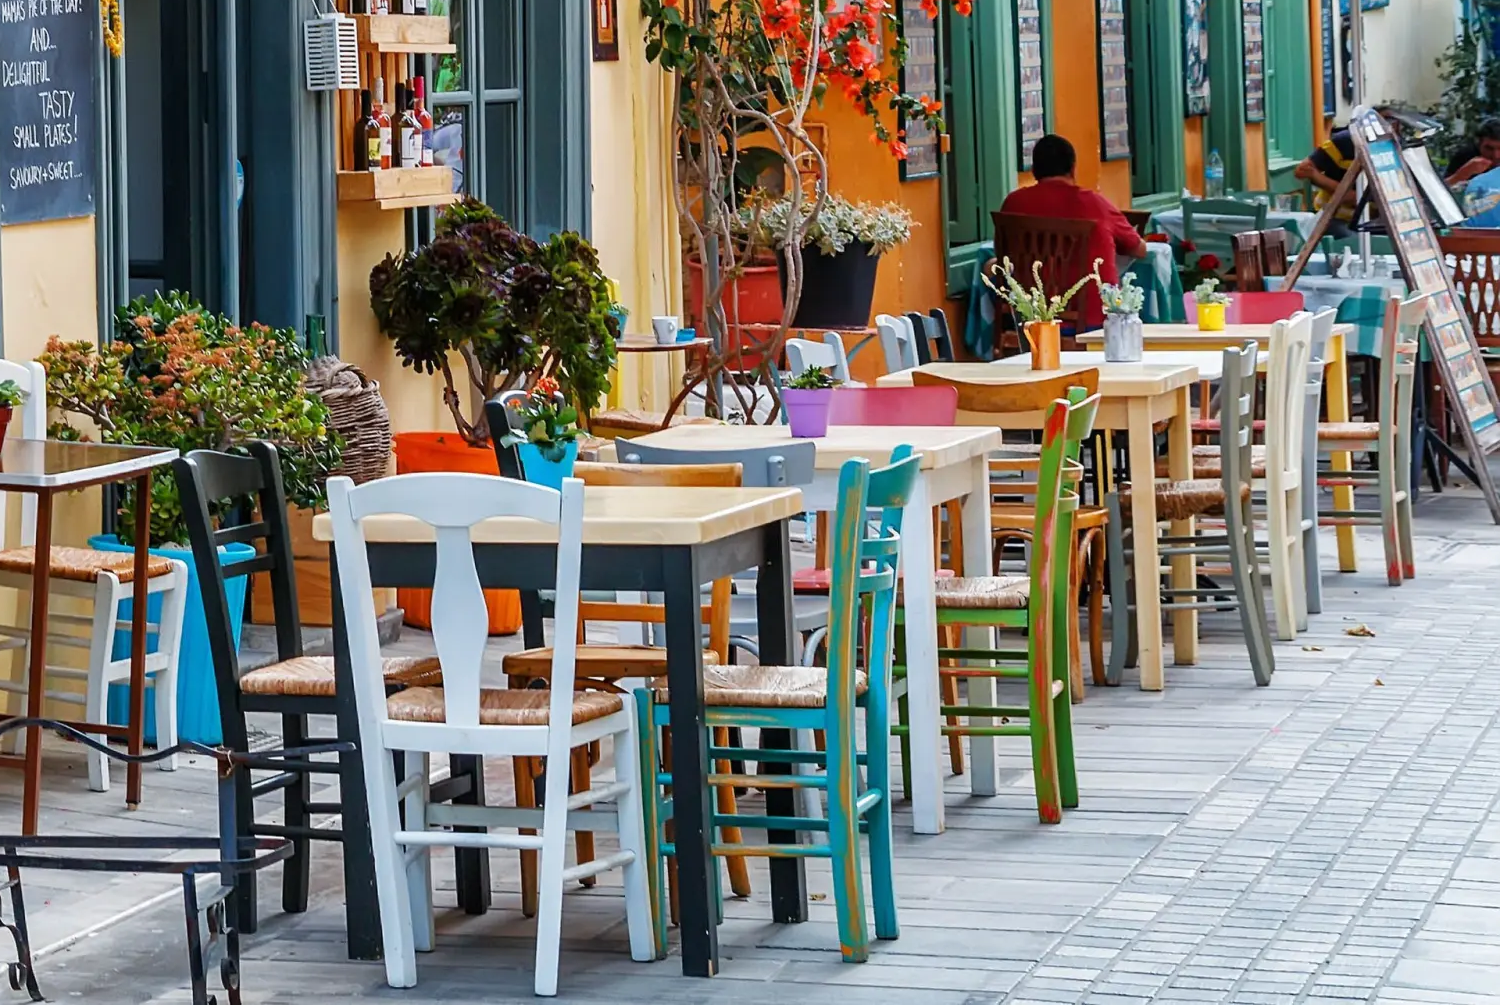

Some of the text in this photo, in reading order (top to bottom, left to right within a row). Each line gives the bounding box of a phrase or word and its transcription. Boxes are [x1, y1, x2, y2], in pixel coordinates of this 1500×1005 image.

[2, 60, 50, 87] DELIGHTFUL
[38, 90, 75, 120] TASTY
[13, 124, 40, 149] SMALL
